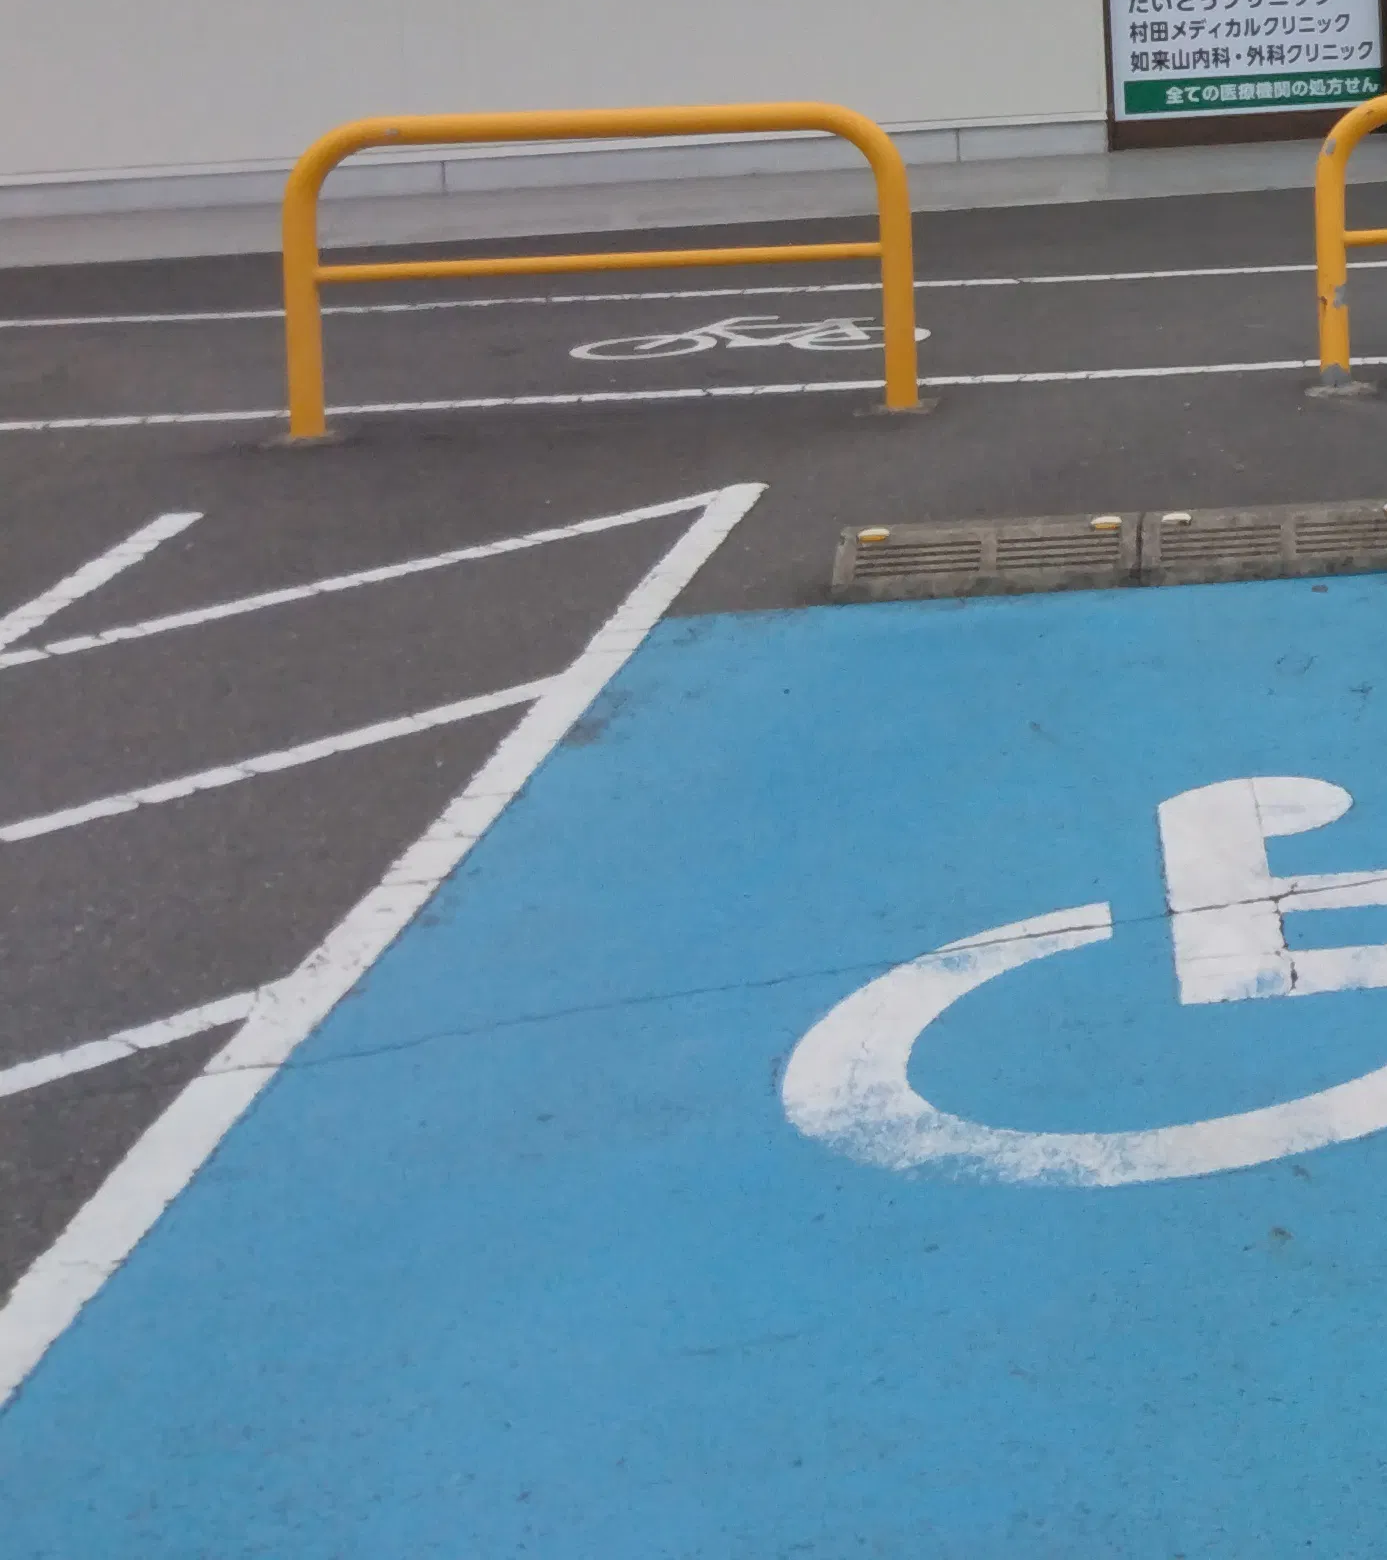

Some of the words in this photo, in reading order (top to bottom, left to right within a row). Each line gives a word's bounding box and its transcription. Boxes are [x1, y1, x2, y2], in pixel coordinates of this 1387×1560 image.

[1129, 13, 1351, 44] 村田メディカルクリニック
[1130, 40, 1374, 73] 如来山内科・外科クリニック
[1165, 76, 1380, 105] 全ての医療機関の処方せん
